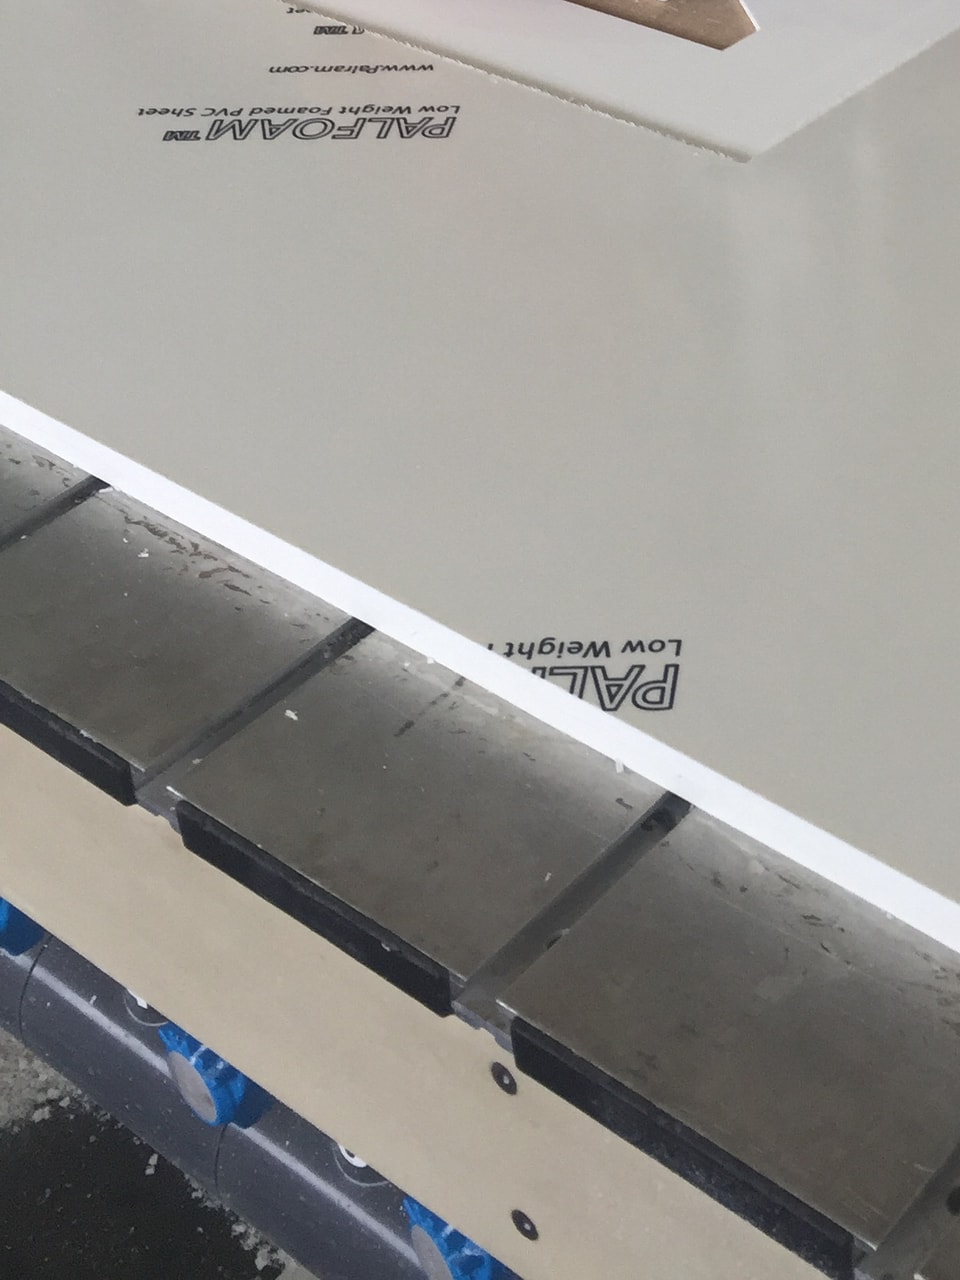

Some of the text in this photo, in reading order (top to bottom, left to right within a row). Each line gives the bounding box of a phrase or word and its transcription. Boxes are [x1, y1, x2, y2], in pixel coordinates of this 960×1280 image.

[269, 64, 434, 74] www.Palram.com
[138, 105, 460, 117] Low Weight Foamed PVC Sheet
[503, 637, 611, 660] Weight
[621, 639, 682, 657] Low
[531, 663, 680, 712] PAL
